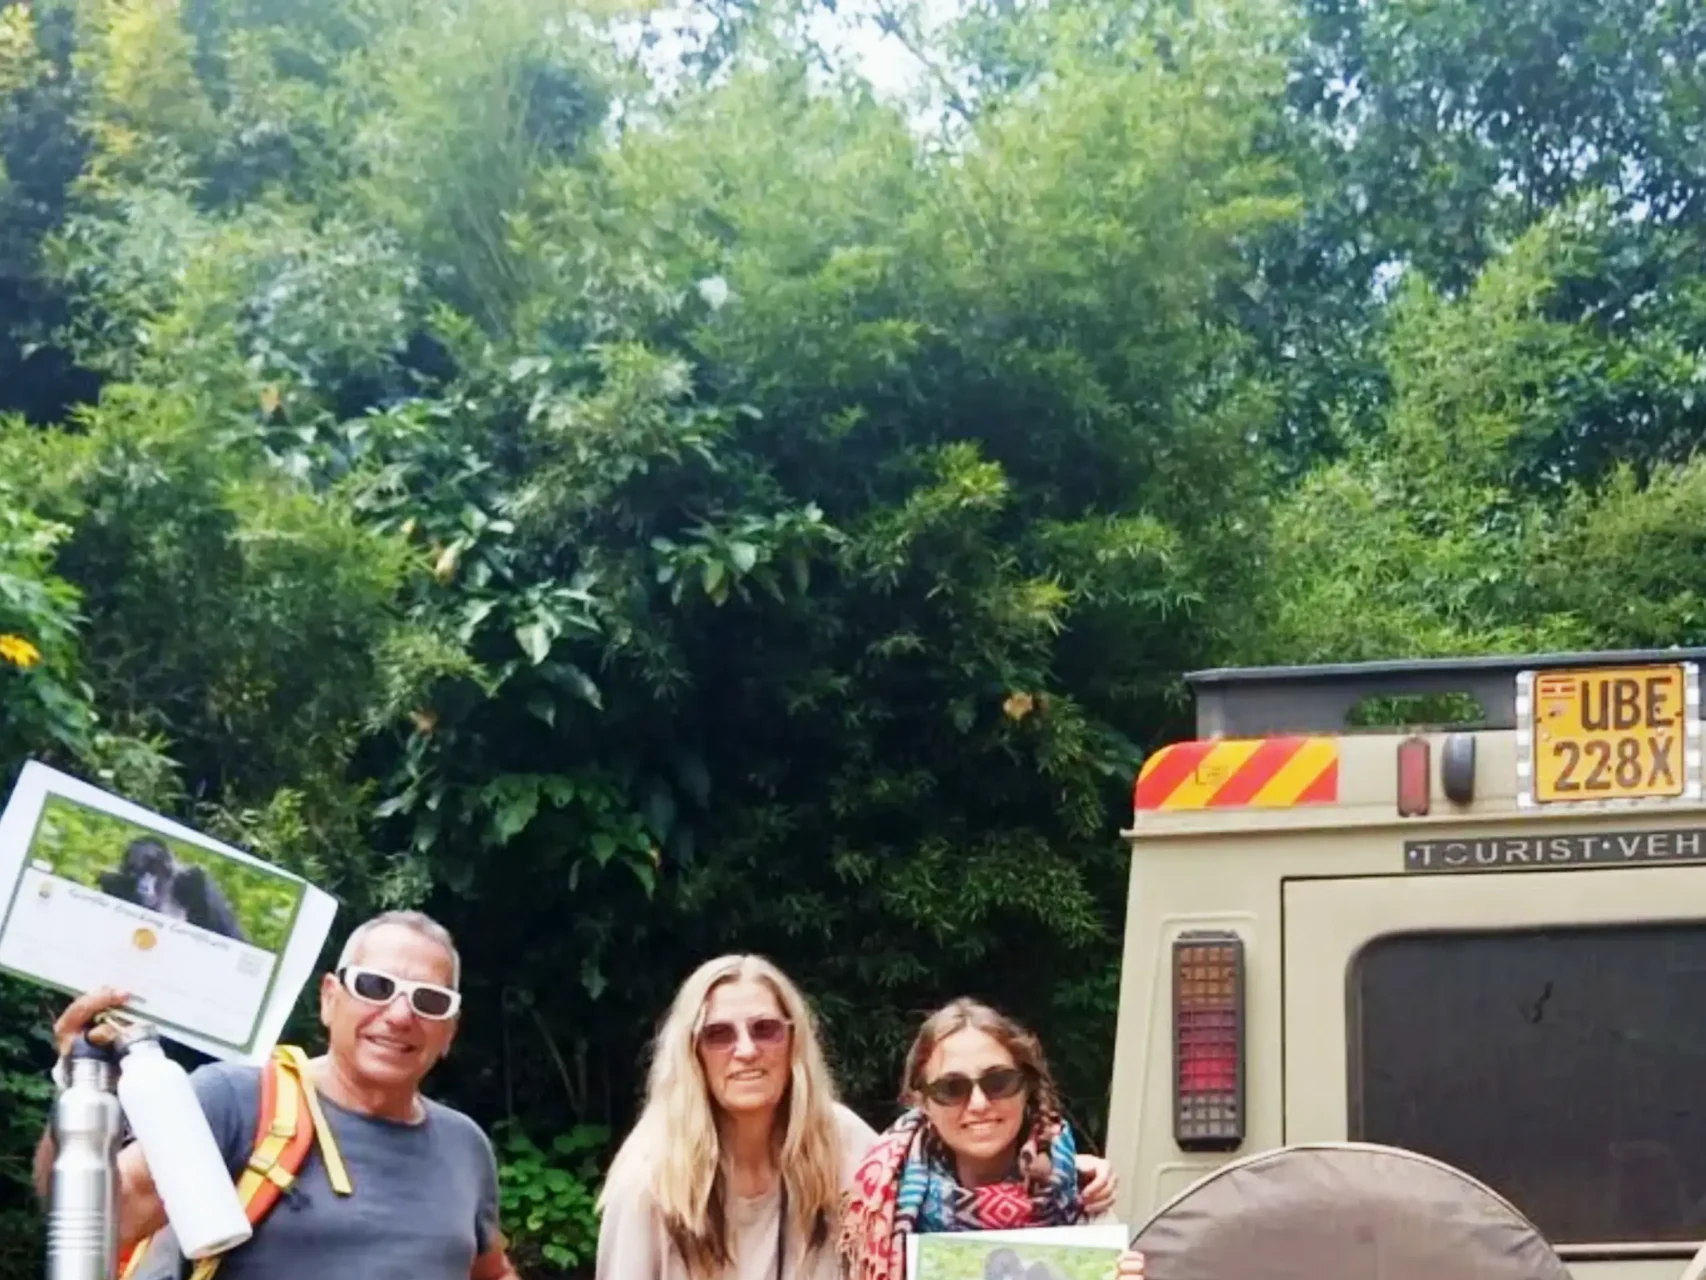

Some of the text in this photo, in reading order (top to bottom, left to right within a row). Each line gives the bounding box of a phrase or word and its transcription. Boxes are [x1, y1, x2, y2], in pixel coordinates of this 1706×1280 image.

[1580, 676, 1675, 731] UBE
[1552, 736, 1675, 792] 228X
[1415, 837, 1599, 867] TOURIST
